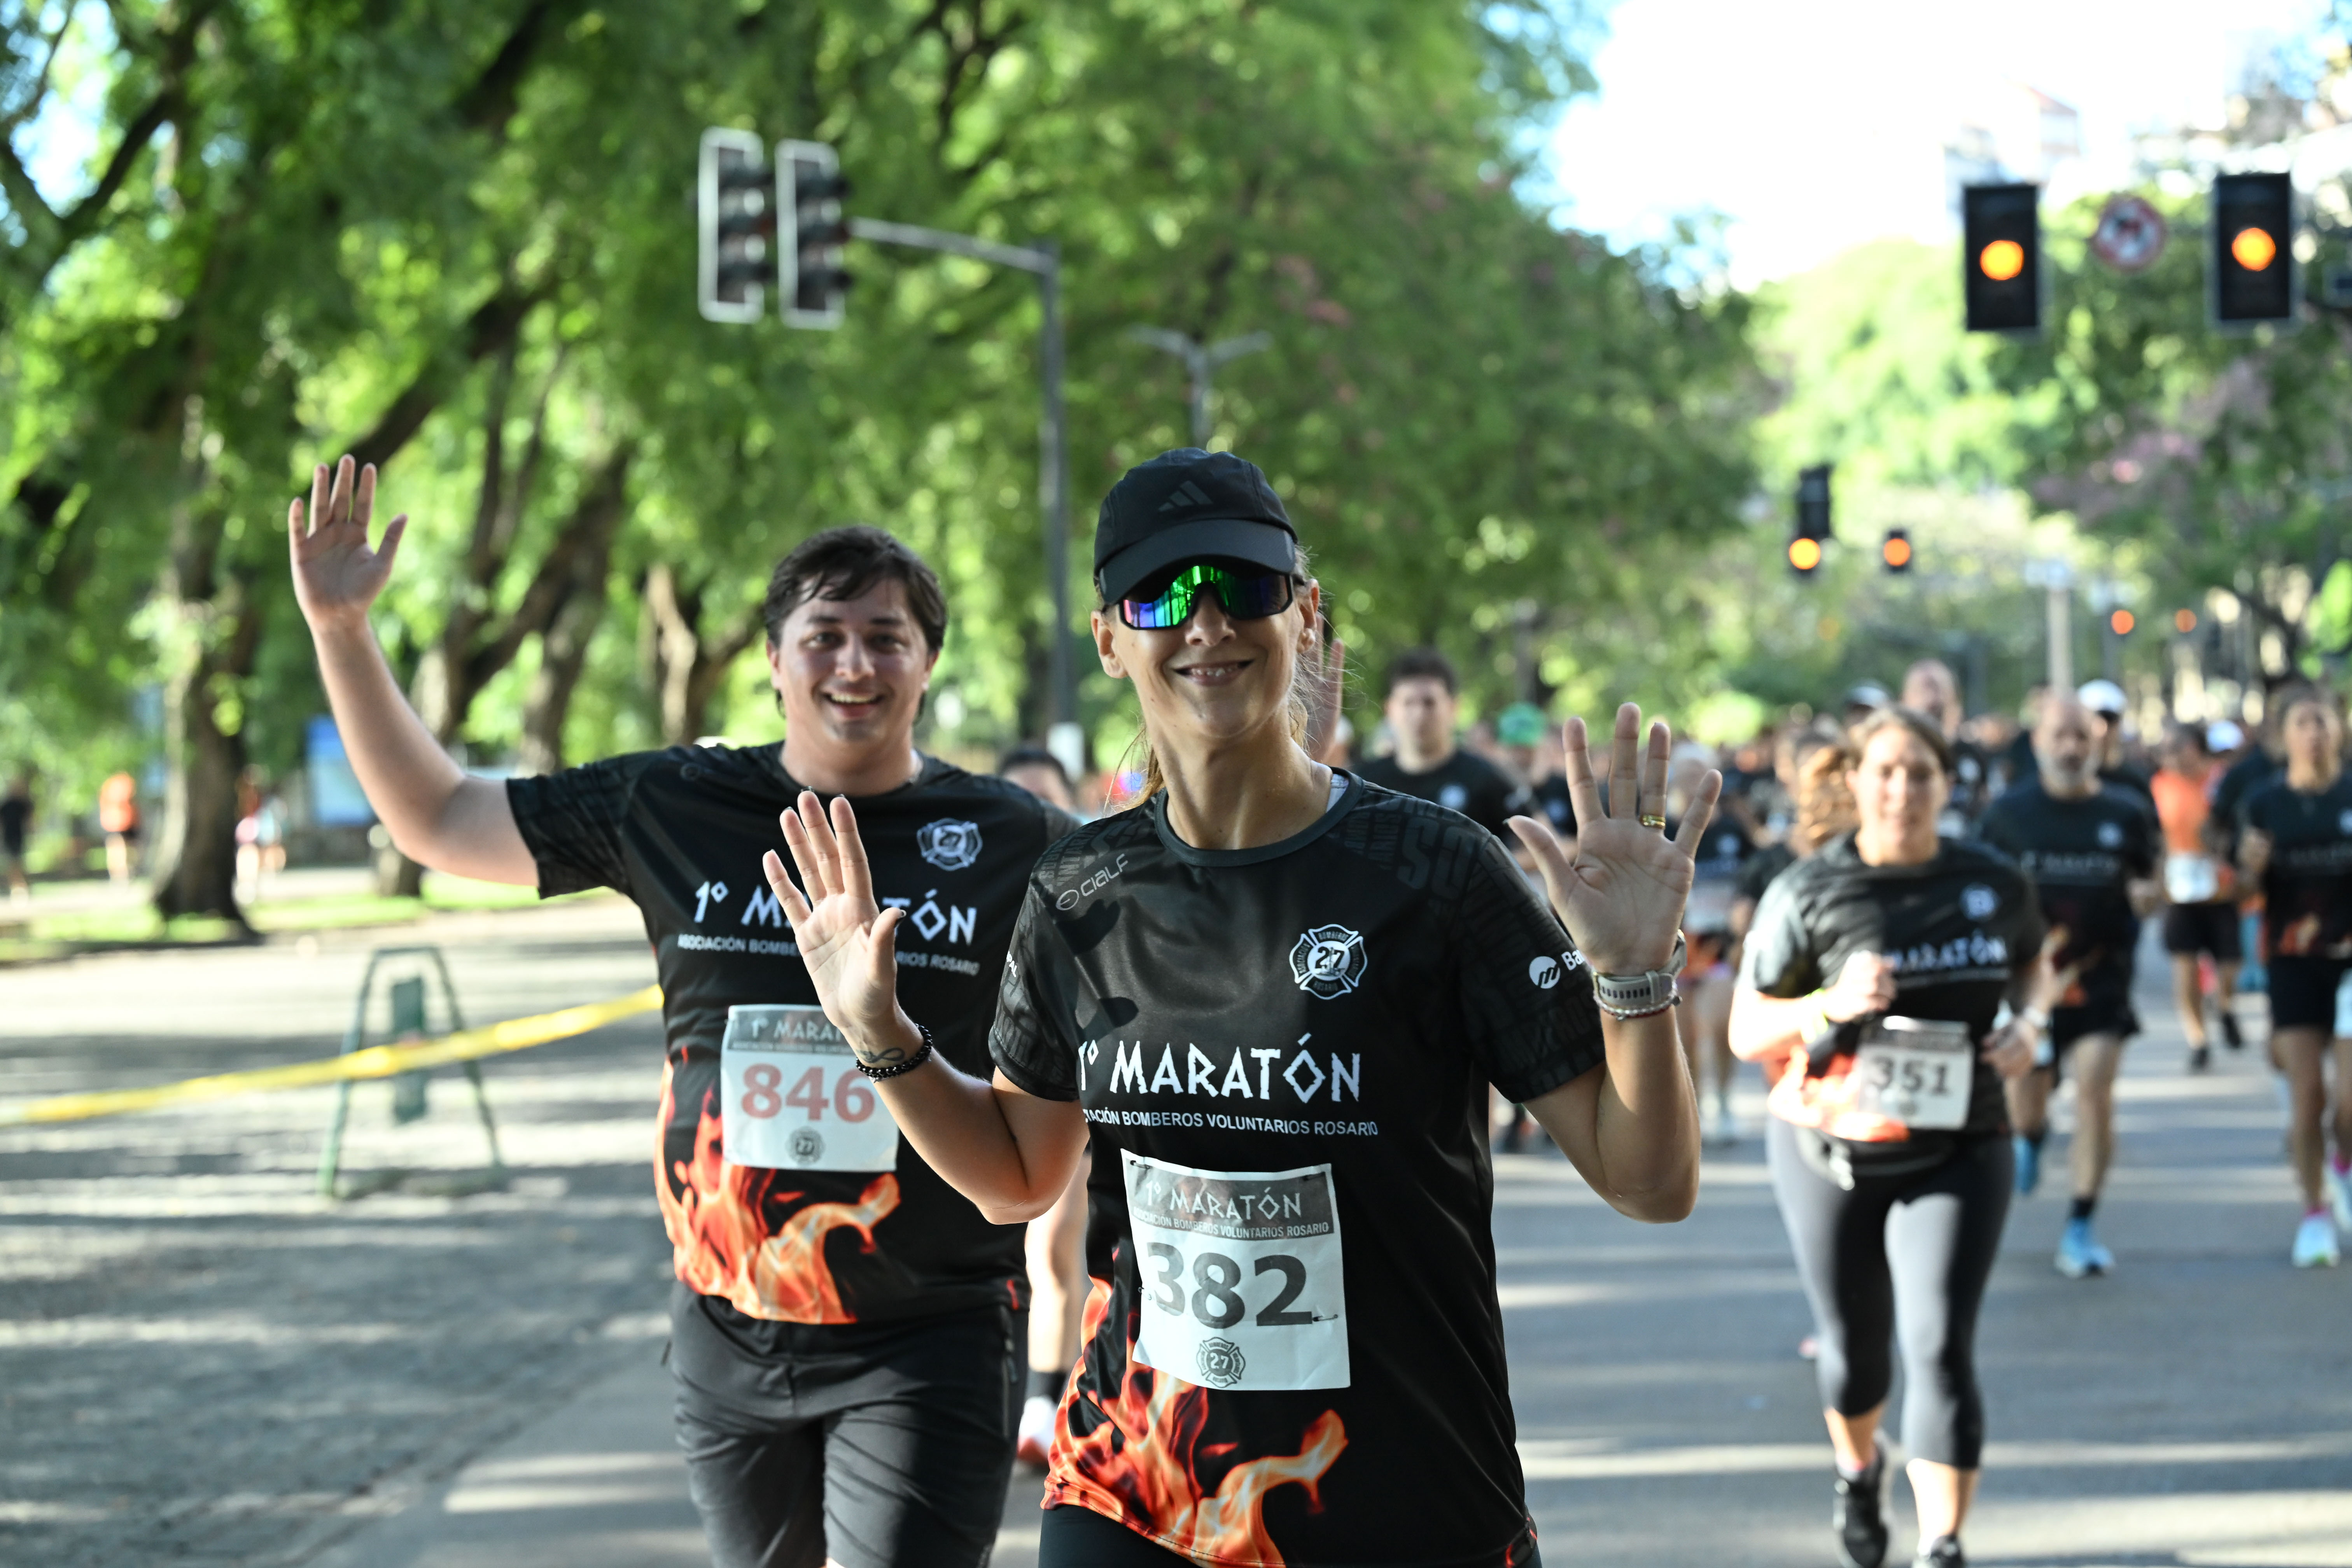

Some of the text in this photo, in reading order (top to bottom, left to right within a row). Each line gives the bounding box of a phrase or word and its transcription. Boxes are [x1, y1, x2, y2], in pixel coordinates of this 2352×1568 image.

[741, 884, 977, 947] MTÓN
[749, 938, 802, 957] BOMBE
[1315, 946, 1345, 969] 27
[773, 1019, 843, 1042] MARA
[1109, 1032, 1361, 1104] MARATÓN
[1870, 1055, 1952, 1097] 351
[741, 1063, 875, 1123] 846
[1122, 1111, 1204, 1128] BOMBEROS
[1206, 1113, 1310, 1135] VOLUNTARIOS
[1314, 1122, 1378, 1136] ROSARIO
[1170, 1186, 1301, 1224] MARATÓN
[1173, 1218, 1218, 1236] BOMBEROS
[1220, 1224, 1284, 1238] VOLUNTARIOS
[1286, 1221, 1329, 1237] ROSARIO
[1147, 1242, 1313, 1329] 382
[1209, 1352, 1229, 1369] 27
